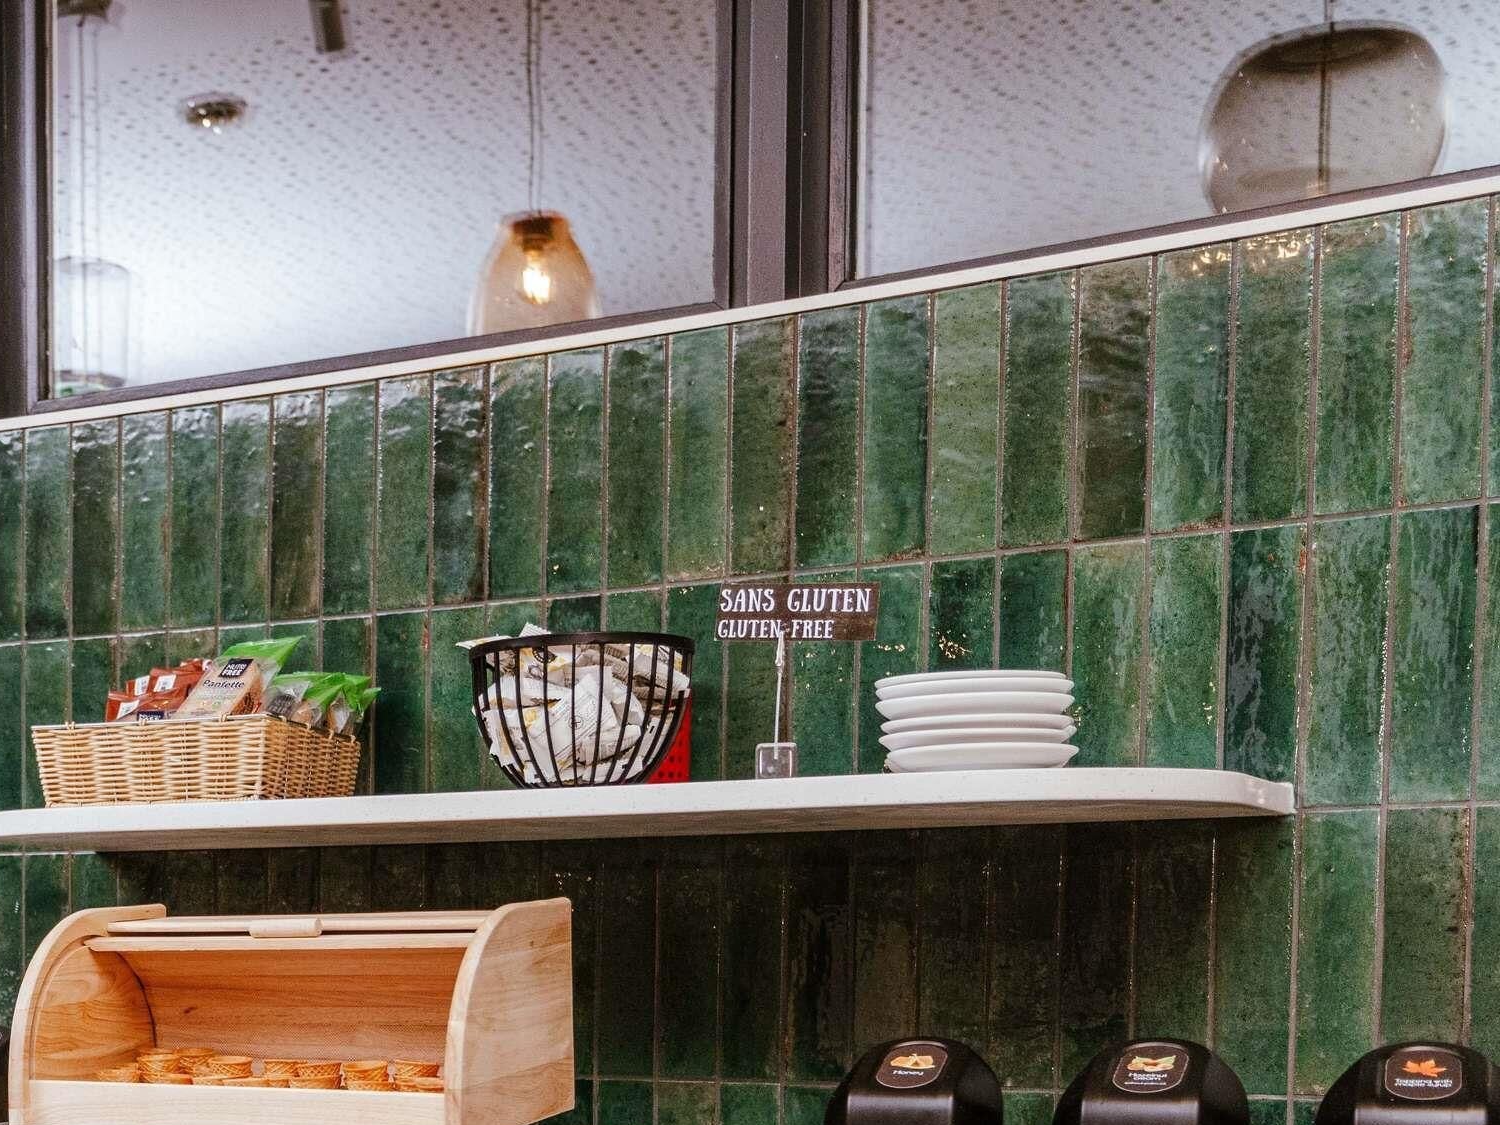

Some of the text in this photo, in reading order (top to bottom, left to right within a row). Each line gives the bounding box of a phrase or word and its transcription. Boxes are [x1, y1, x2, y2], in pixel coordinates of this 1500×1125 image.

[720, 588, 872, 613] SANS GLUTEN
[717, 619, 835, 639] GLUTEN FREE
